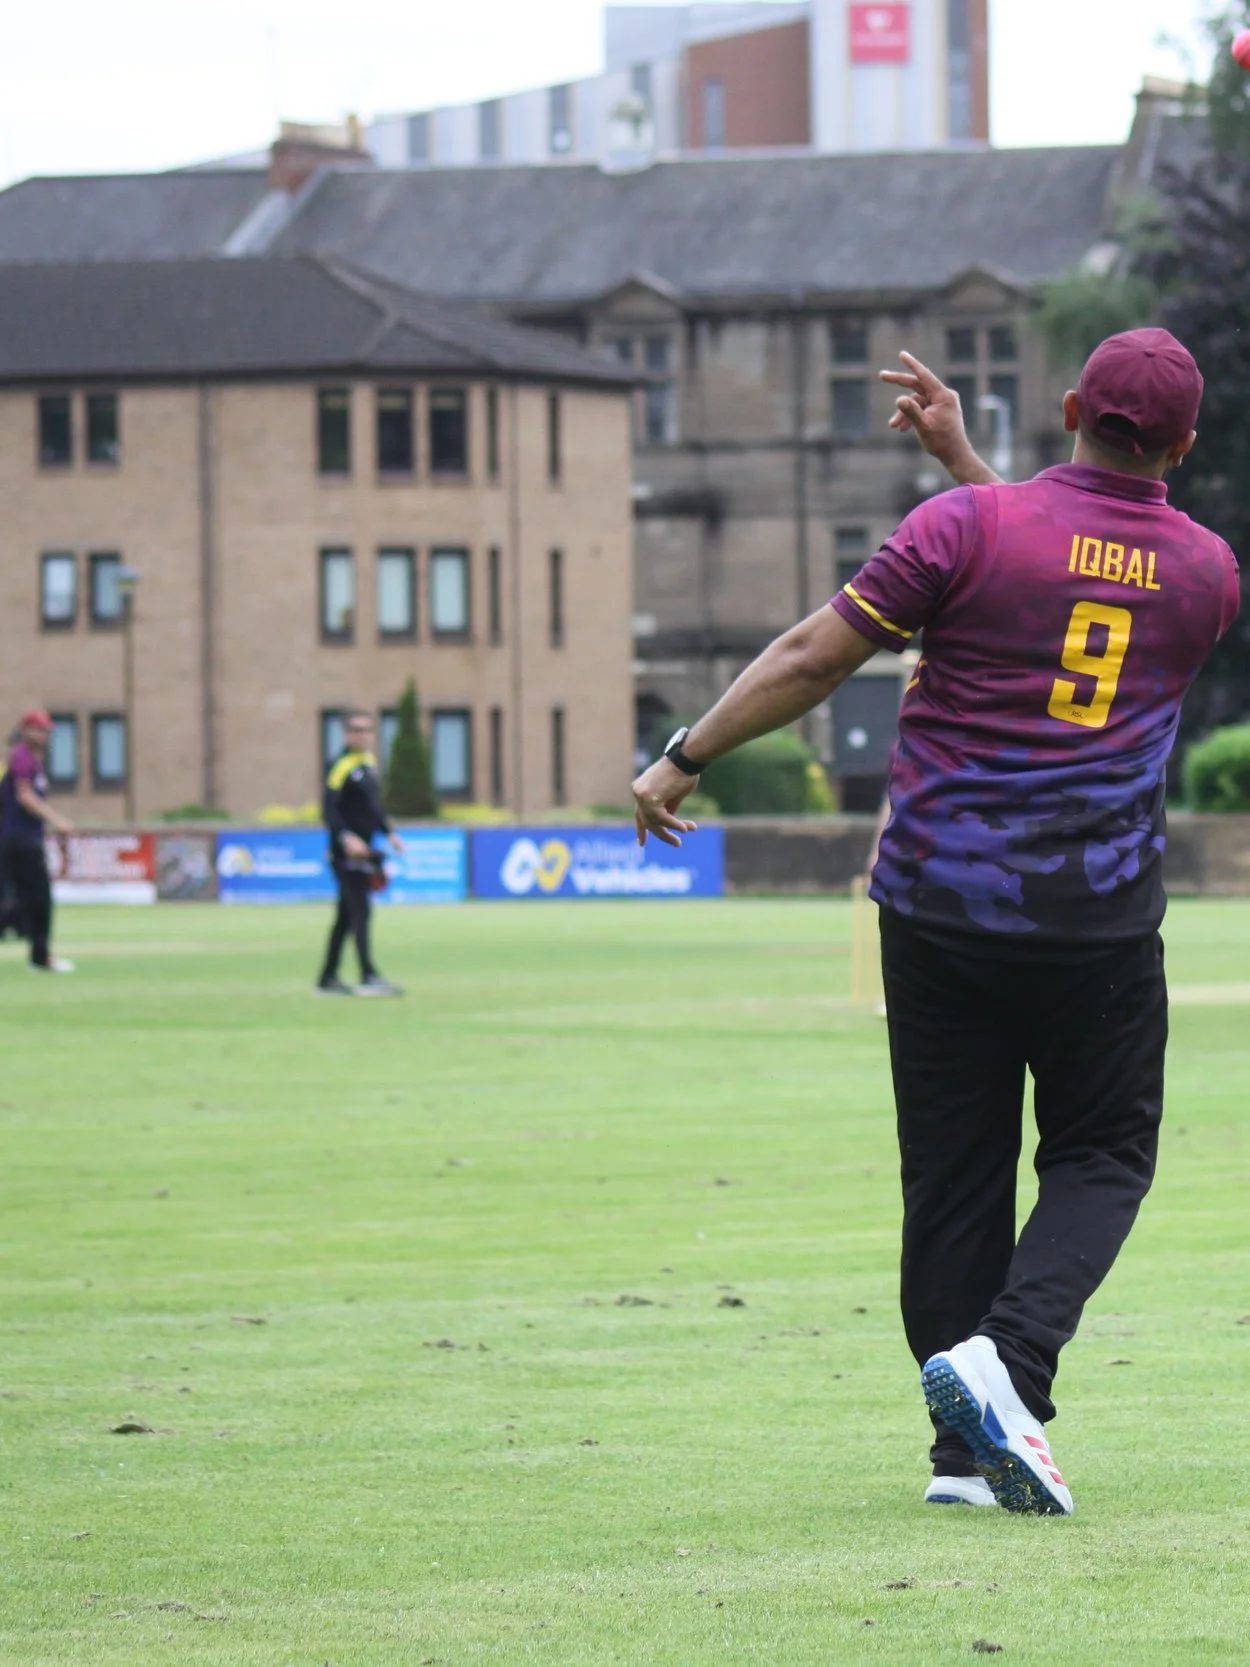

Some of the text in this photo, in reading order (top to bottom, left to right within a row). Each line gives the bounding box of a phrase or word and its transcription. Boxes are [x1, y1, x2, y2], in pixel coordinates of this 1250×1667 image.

[1069, 535, 1160, 590] IQBAL
[1048, 601, 1132, 728] 9
[571, 863, 691, 893] Vehicles
